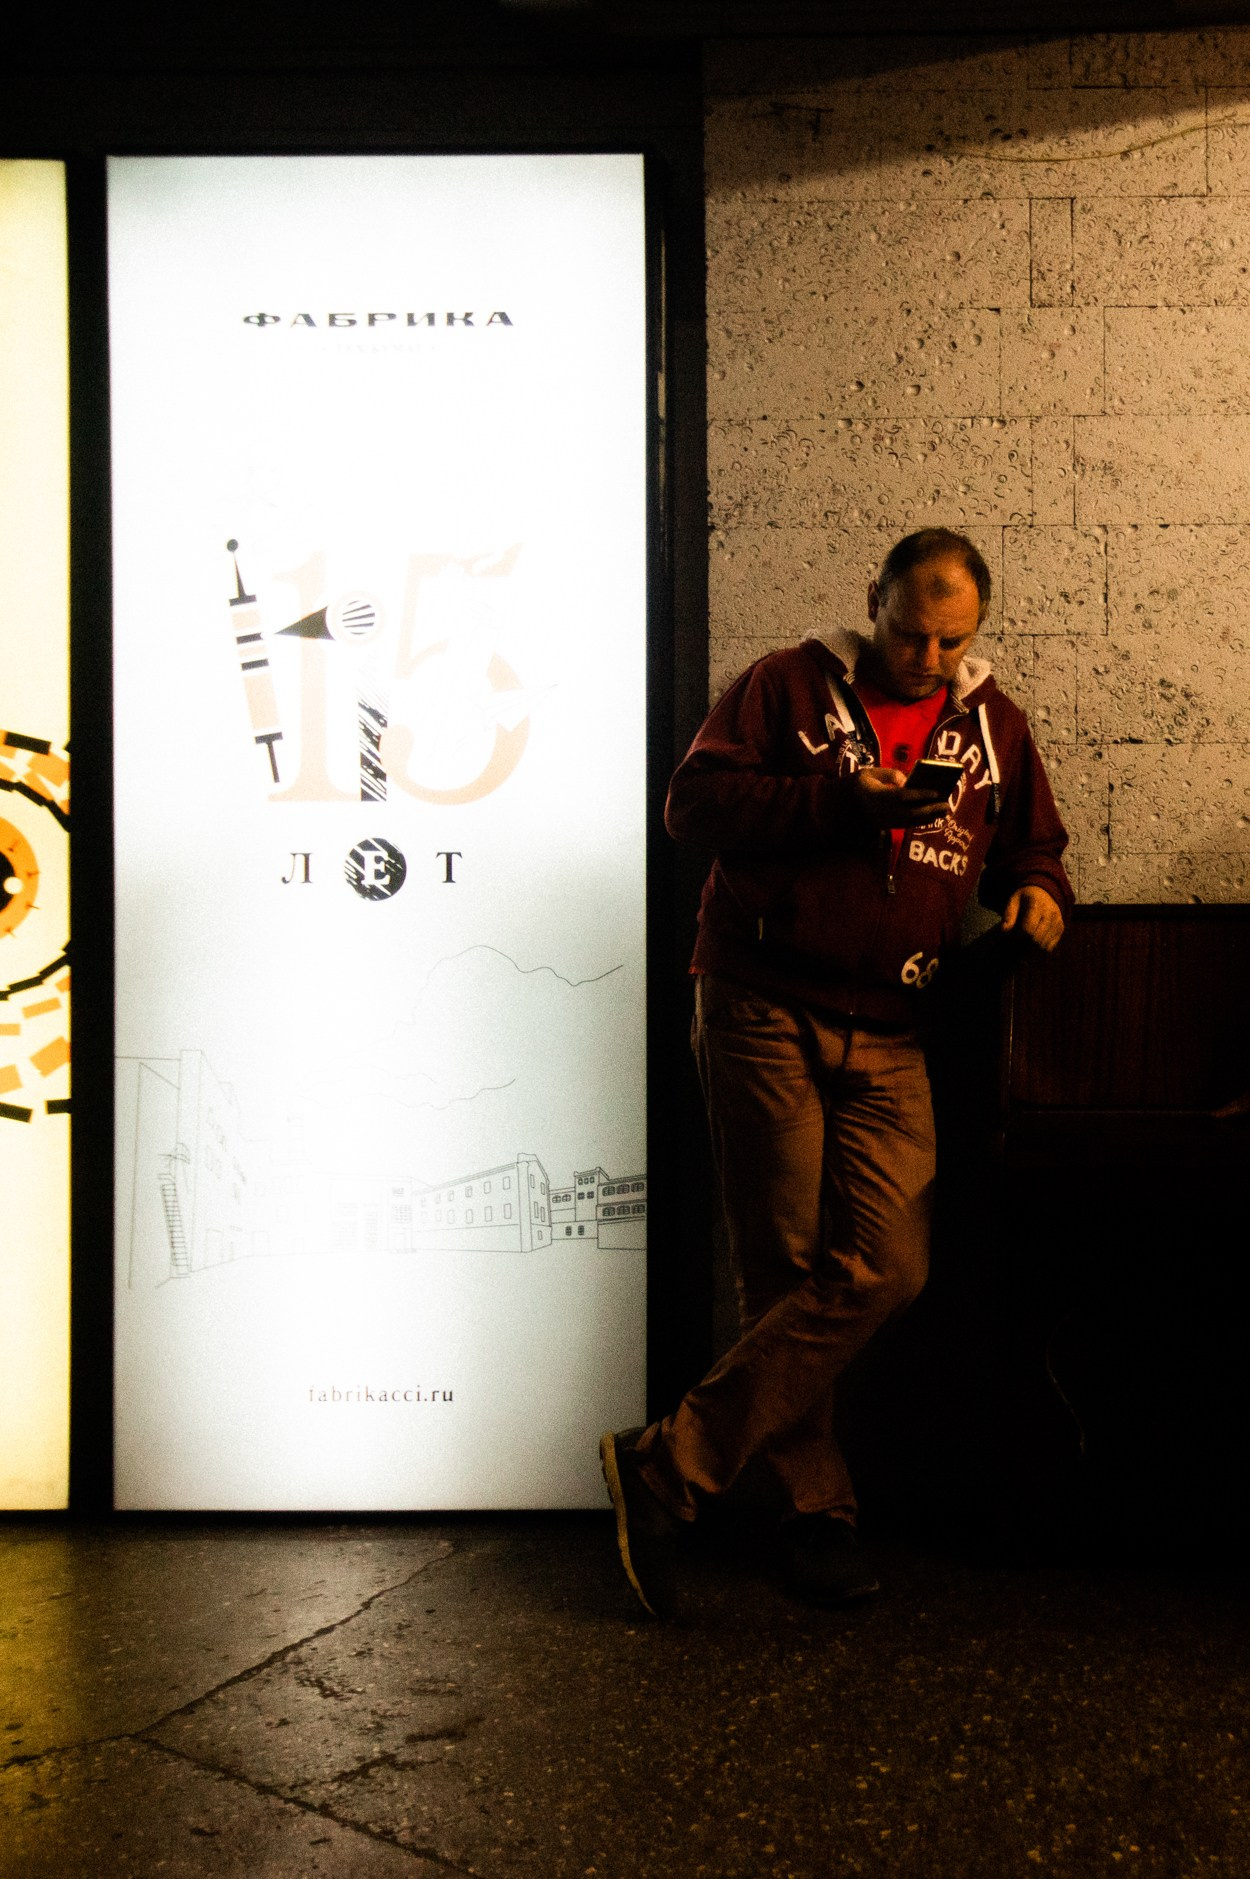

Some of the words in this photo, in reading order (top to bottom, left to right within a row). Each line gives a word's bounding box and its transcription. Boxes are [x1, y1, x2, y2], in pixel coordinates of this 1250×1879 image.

[243, 311, 513, 328] ФАБРИКА
[281, 851, 463, 886] ЛЕТ
[908, 840, 969, 876] BACKS
[901, 951, 939, 989] 68
[309, 1384, 454, 1402] fabrikacci.ru
